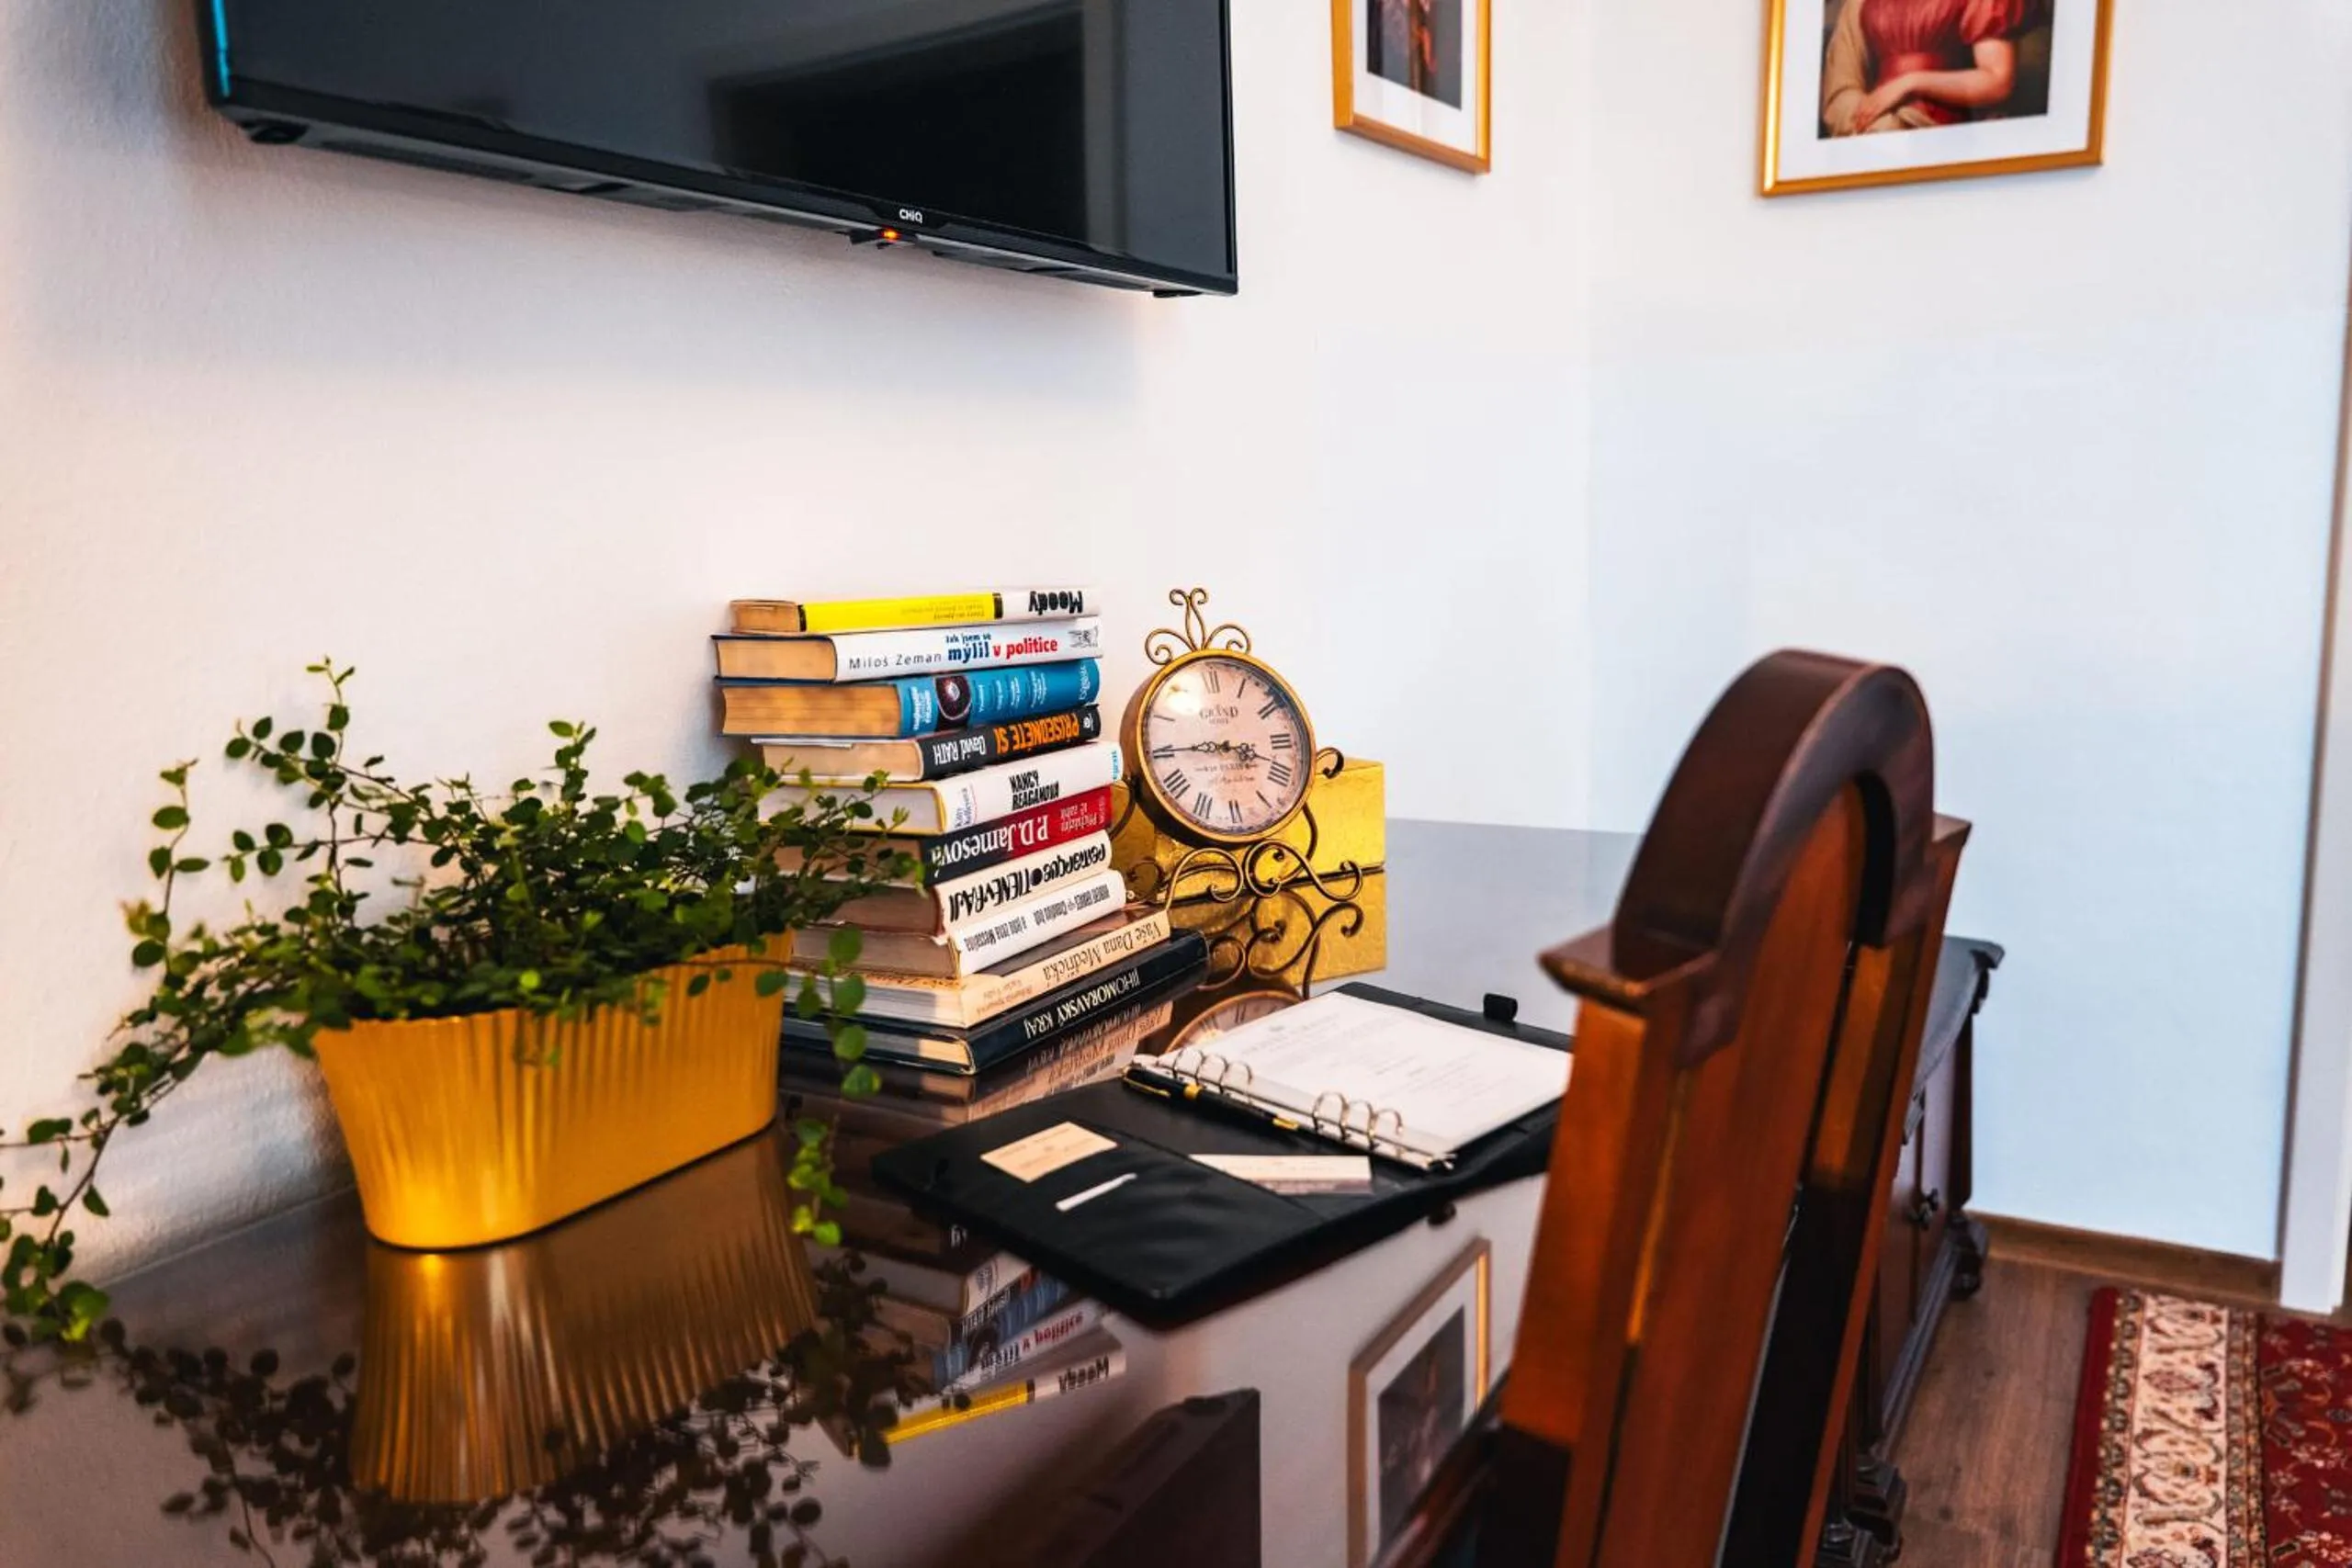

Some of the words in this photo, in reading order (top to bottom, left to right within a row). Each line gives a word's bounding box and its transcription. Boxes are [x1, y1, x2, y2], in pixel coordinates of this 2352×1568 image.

[1028, 591, 1083, 615] Moody
[947, 641, 990, 664] mýlil
[992, 645, 1002, 659] v
[1005, 637, 1058, 660] politice
[961, 633, 981, 644] jsem
[849, 656, 889, 670] Miloš
[895, 652, 943, 667] Zeman
[933, 739, 960, 765] RATH
[959, 734, 987, 761] David
[1009, 770, 1039, 793] NANCY
[1102, 930, 1135, 955] Dana
[1135, 920, 1162, 943] Vaše
[1056, 966, 1141, 1026] JIHOMORAVSKÝ
[1023, 1010, 1055, 1040] KRAJ
